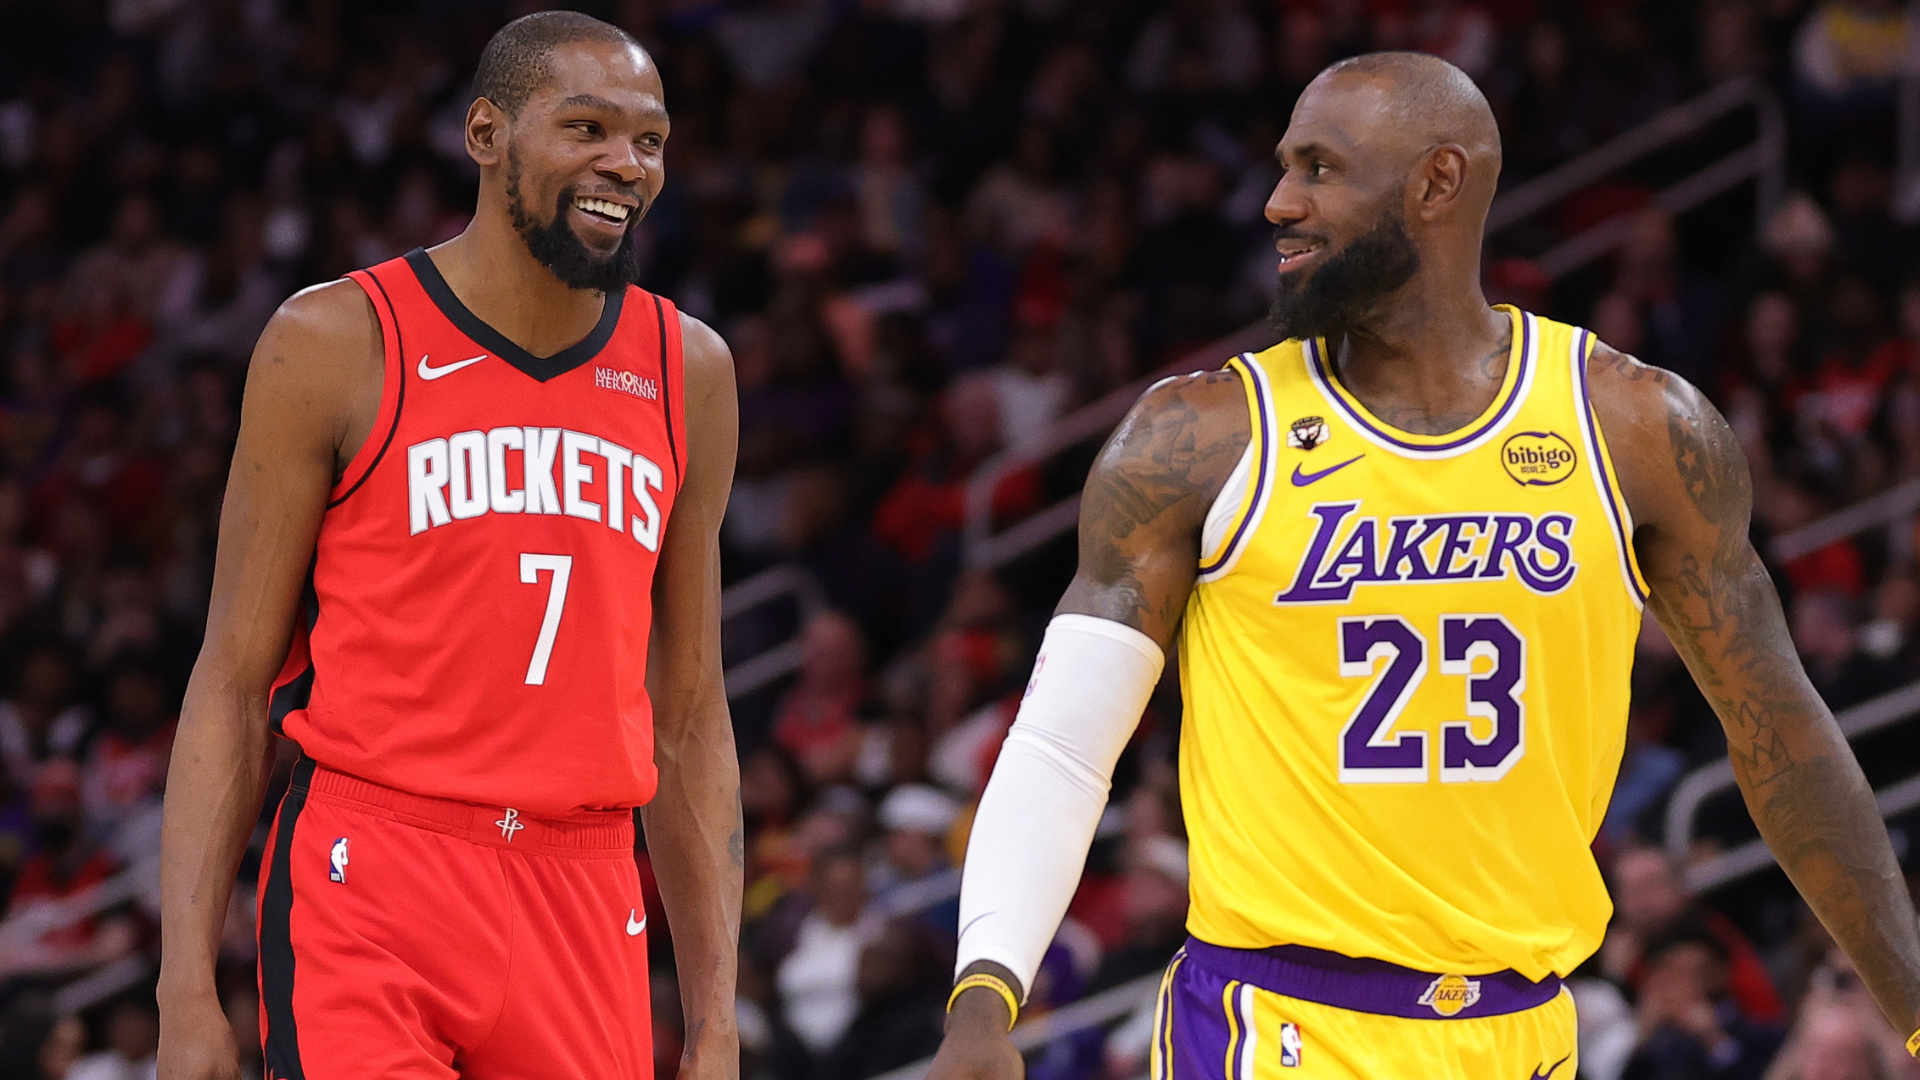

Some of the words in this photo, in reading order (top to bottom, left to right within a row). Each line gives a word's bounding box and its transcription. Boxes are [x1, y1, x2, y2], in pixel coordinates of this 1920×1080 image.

[595, 366, 657, 391] MEMORIAL
[595, 376, 658, 400] HERMANN
[407, 426, 663, 553] ROCKETS
[1507, 445, 1571, 469] bibigo
[1273, 499, 1578, 605] LAKERS
[519, 553, 573, 686] 7
[1337, 614, 1526, 783] 23
